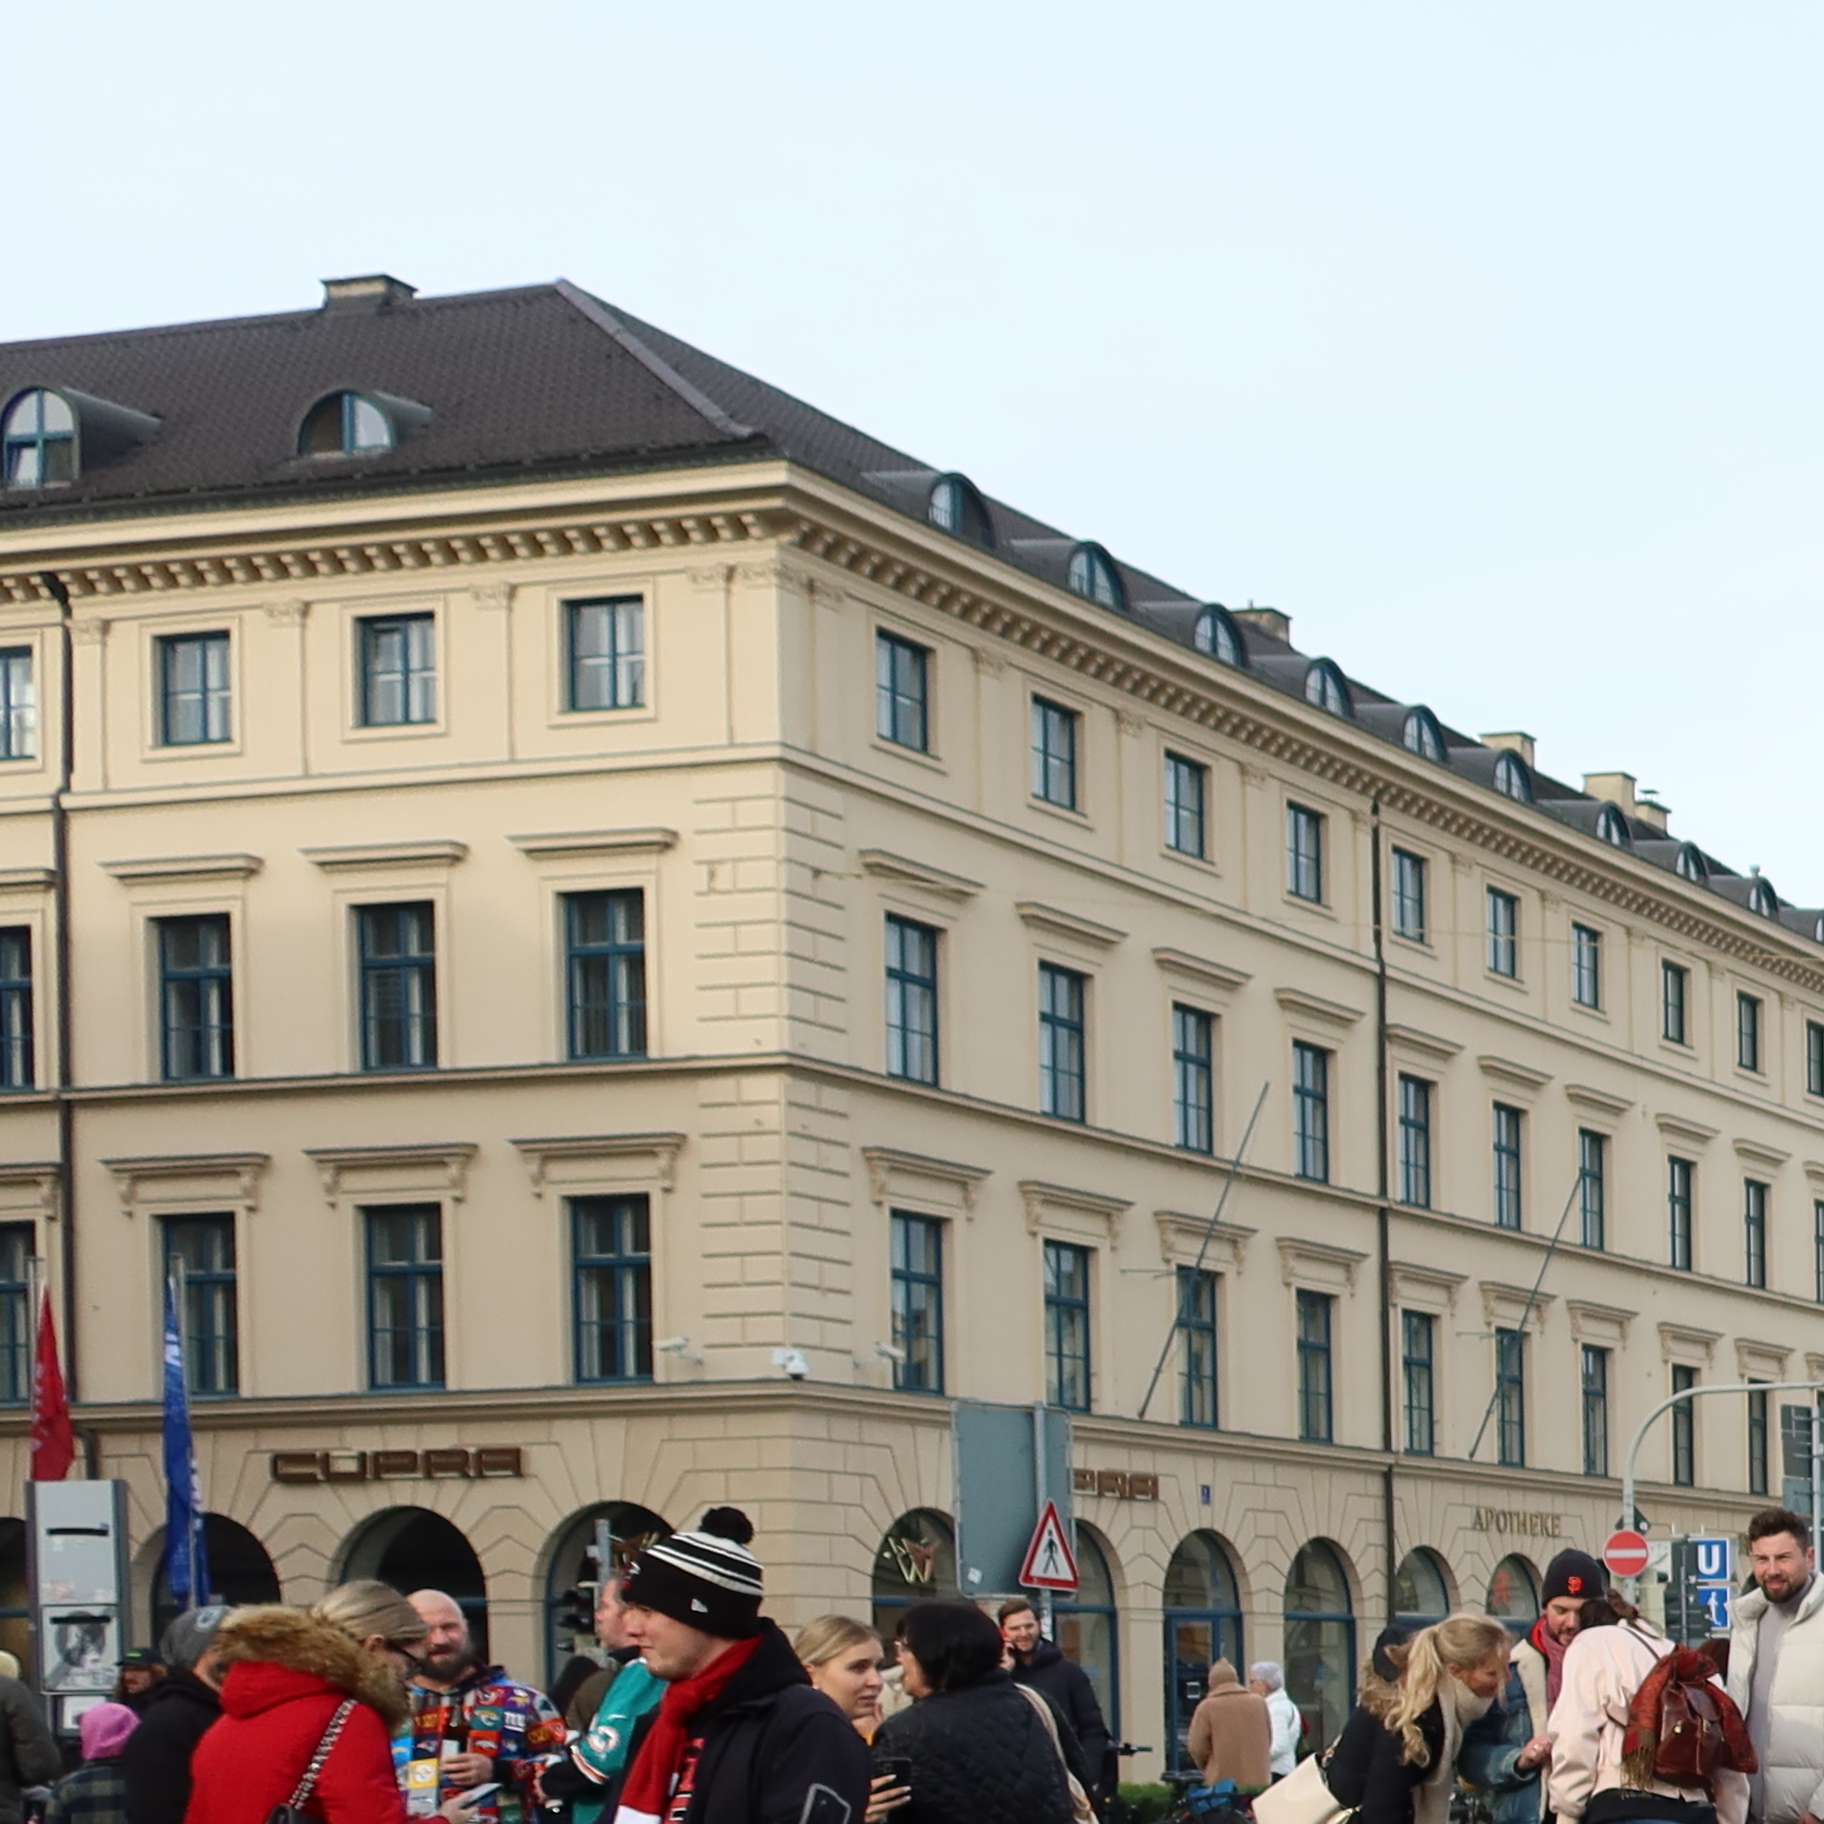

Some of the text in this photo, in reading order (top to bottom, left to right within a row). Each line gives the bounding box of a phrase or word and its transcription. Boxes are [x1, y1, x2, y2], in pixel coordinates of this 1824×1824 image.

[272, 1448, 523, 1483] CUPRA
[1472, 1506, 1562, 1537] APOTHEKE
[1697, 1544, 1720, 1575] U
